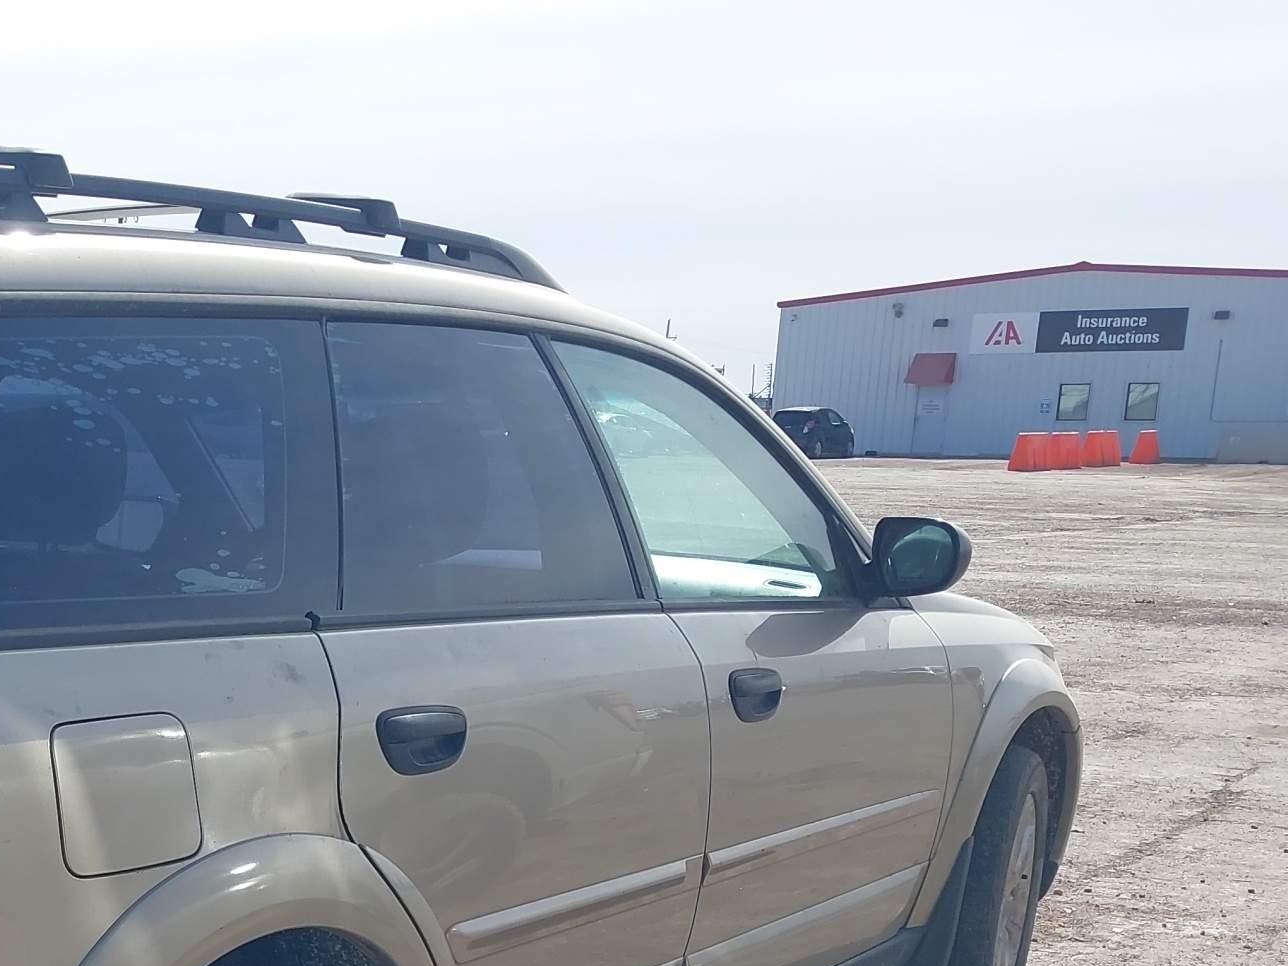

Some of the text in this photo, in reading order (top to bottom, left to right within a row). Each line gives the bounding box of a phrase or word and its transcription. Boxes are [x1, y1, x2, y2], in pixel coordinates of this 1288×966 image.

[1077, 315, 1147, 329] Insurance
[1060, 330, 1160, 346] Auto Auctions
